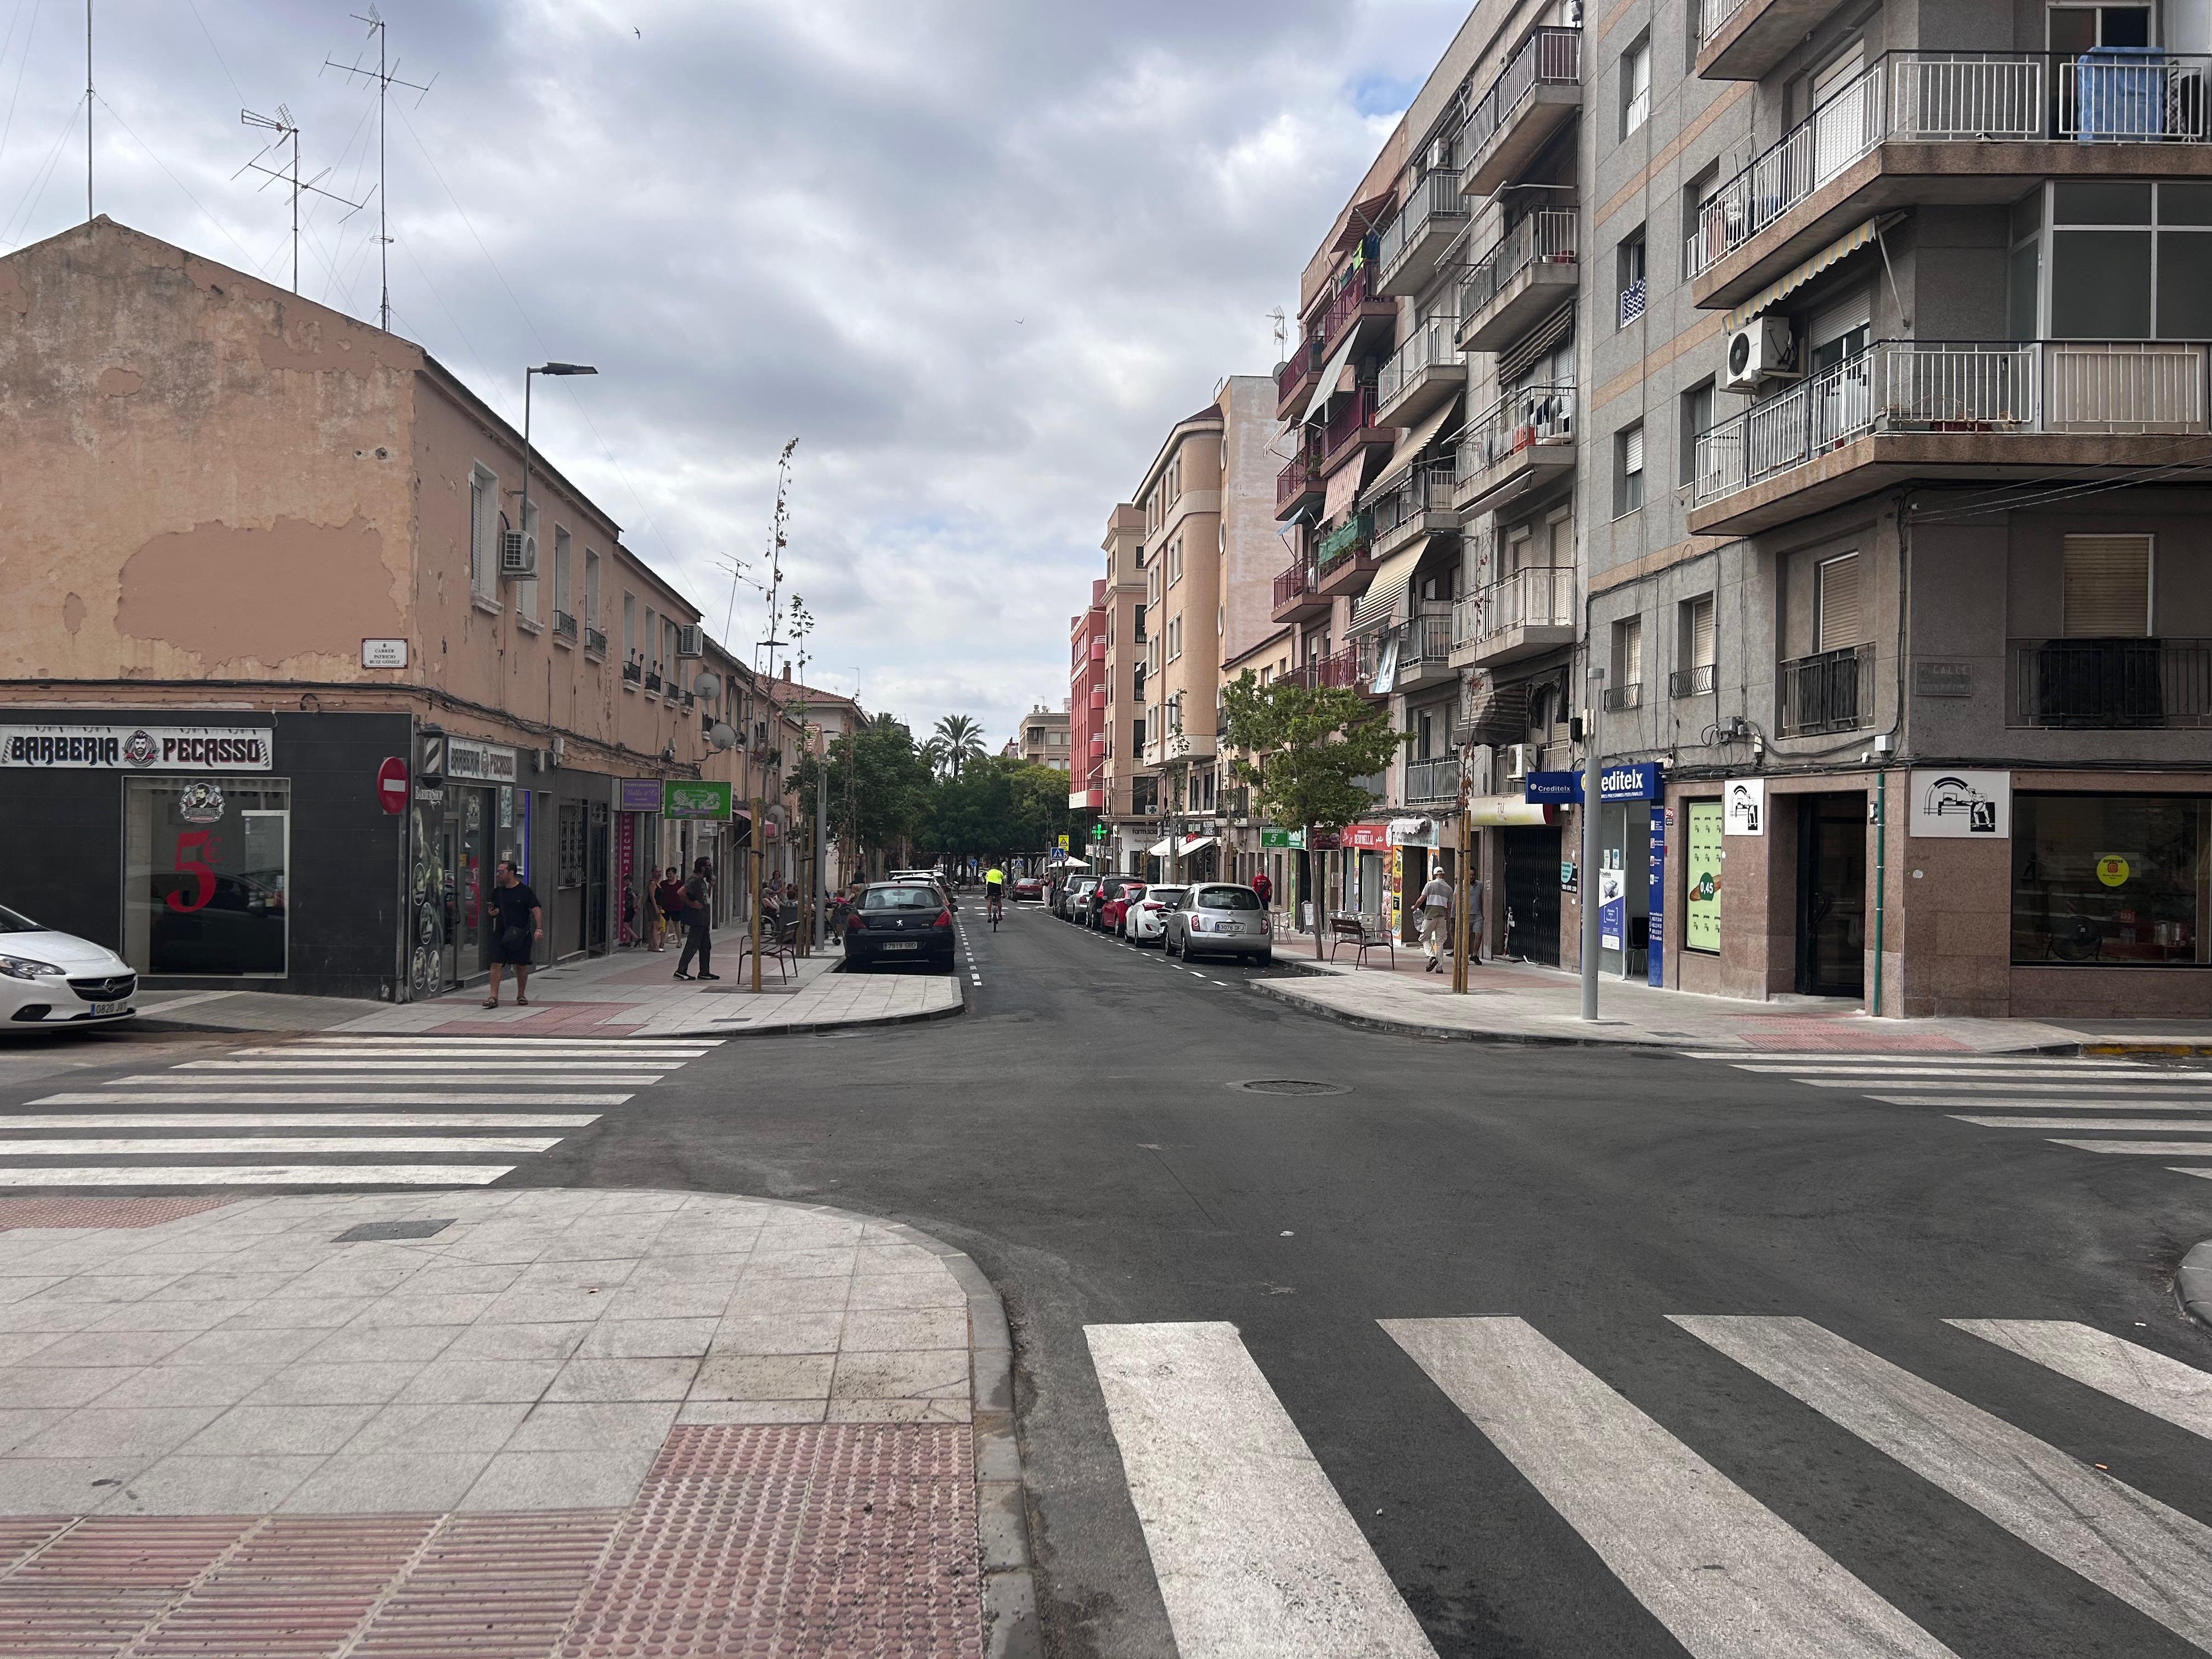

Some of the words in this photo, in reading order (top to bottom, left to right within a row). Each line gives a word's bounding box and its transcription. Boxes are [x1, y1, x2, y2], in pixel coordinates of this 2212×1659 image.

[1933, 665, 1967, 675] CALLE
[12, 737, 119, 766] BARBERIA
[162, 738, 261, 768] PECASSO
[1601, 769, 1644, 792] editelx
[1270, 833, 1278, 843] 5
[1700, 882, 1713, 895] 0,45
[97, 1003, 114, 1014] 0820
[116, 1002, 127, 1012] JVT
